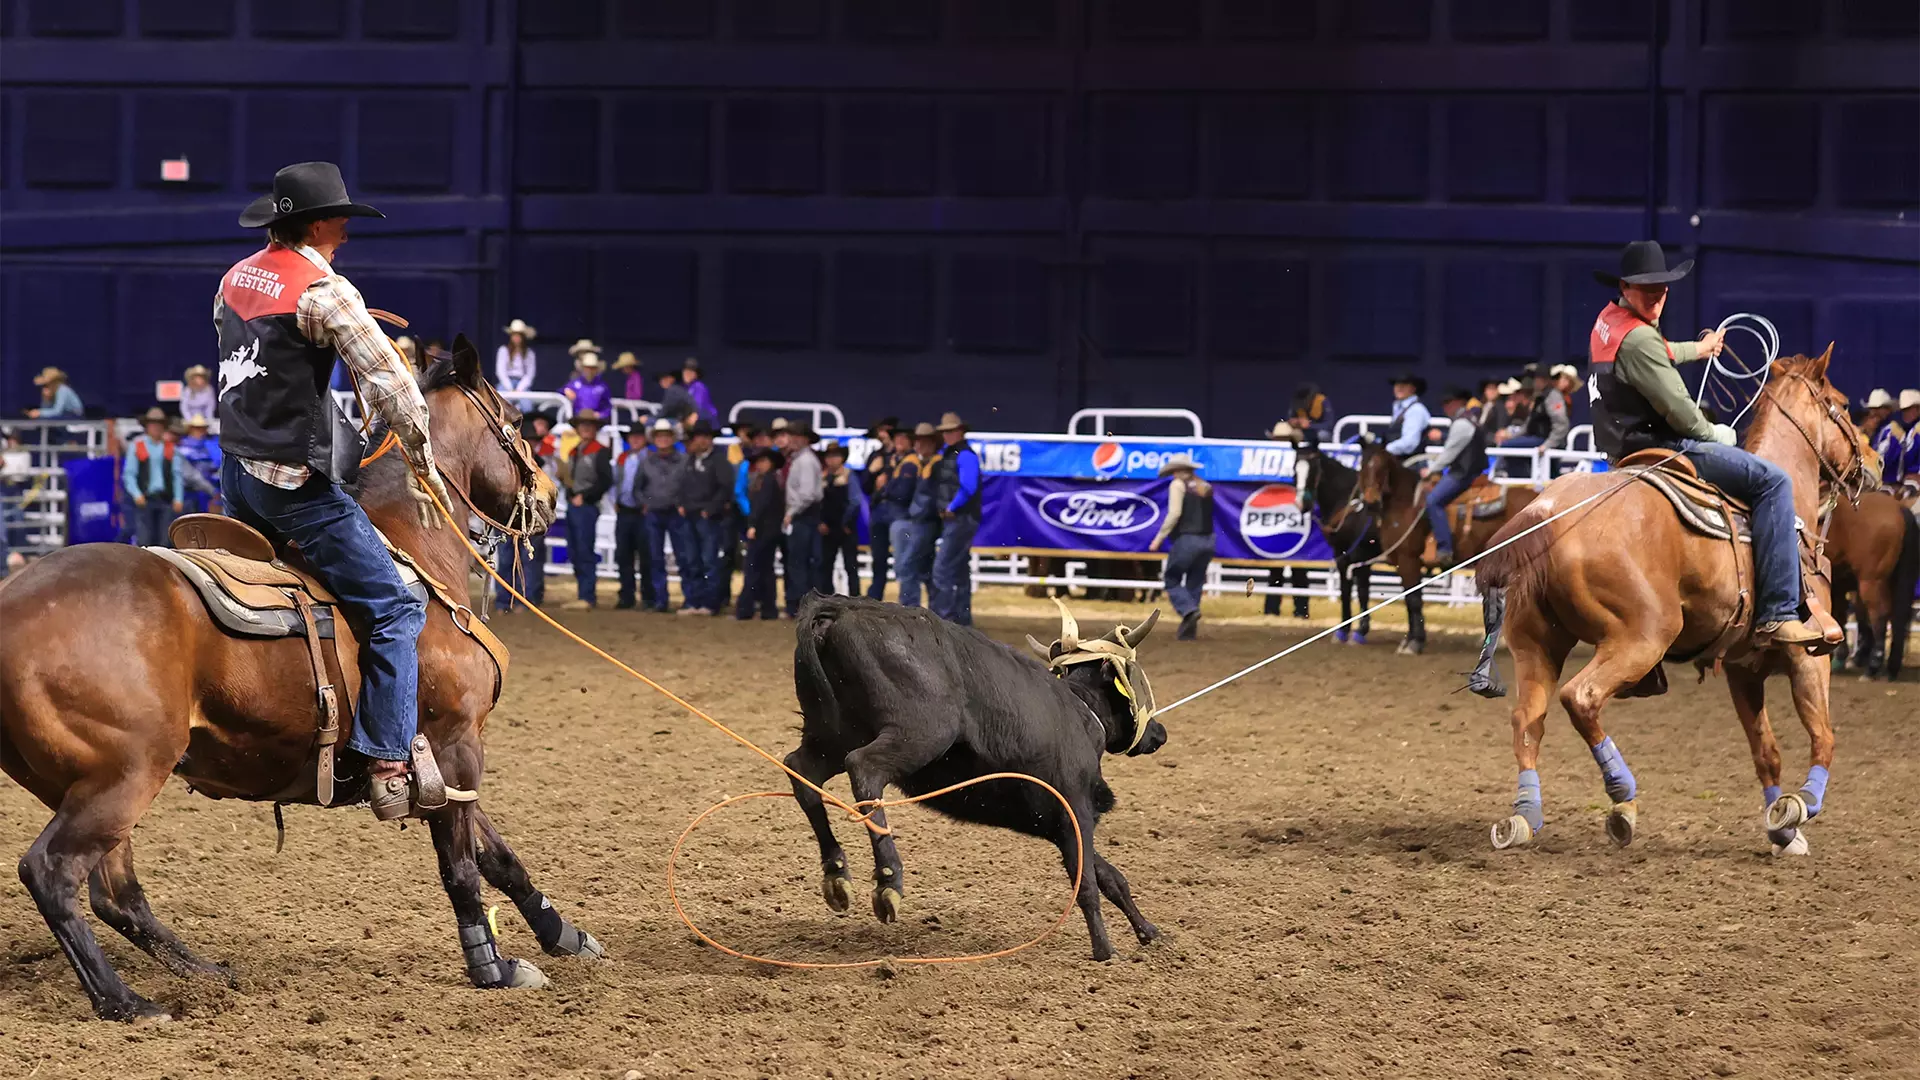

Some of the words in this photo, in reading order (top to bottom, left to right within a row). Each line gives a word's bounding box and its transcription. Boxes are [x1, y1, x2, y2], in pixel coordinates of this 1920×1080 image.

[241, 264, 280, 281] MONTANA
[230, 271, 286, 300] WESTERN
[1060, 493, 1136, 528] Ford
[1246, 511, 1304, 528] PEPSI
